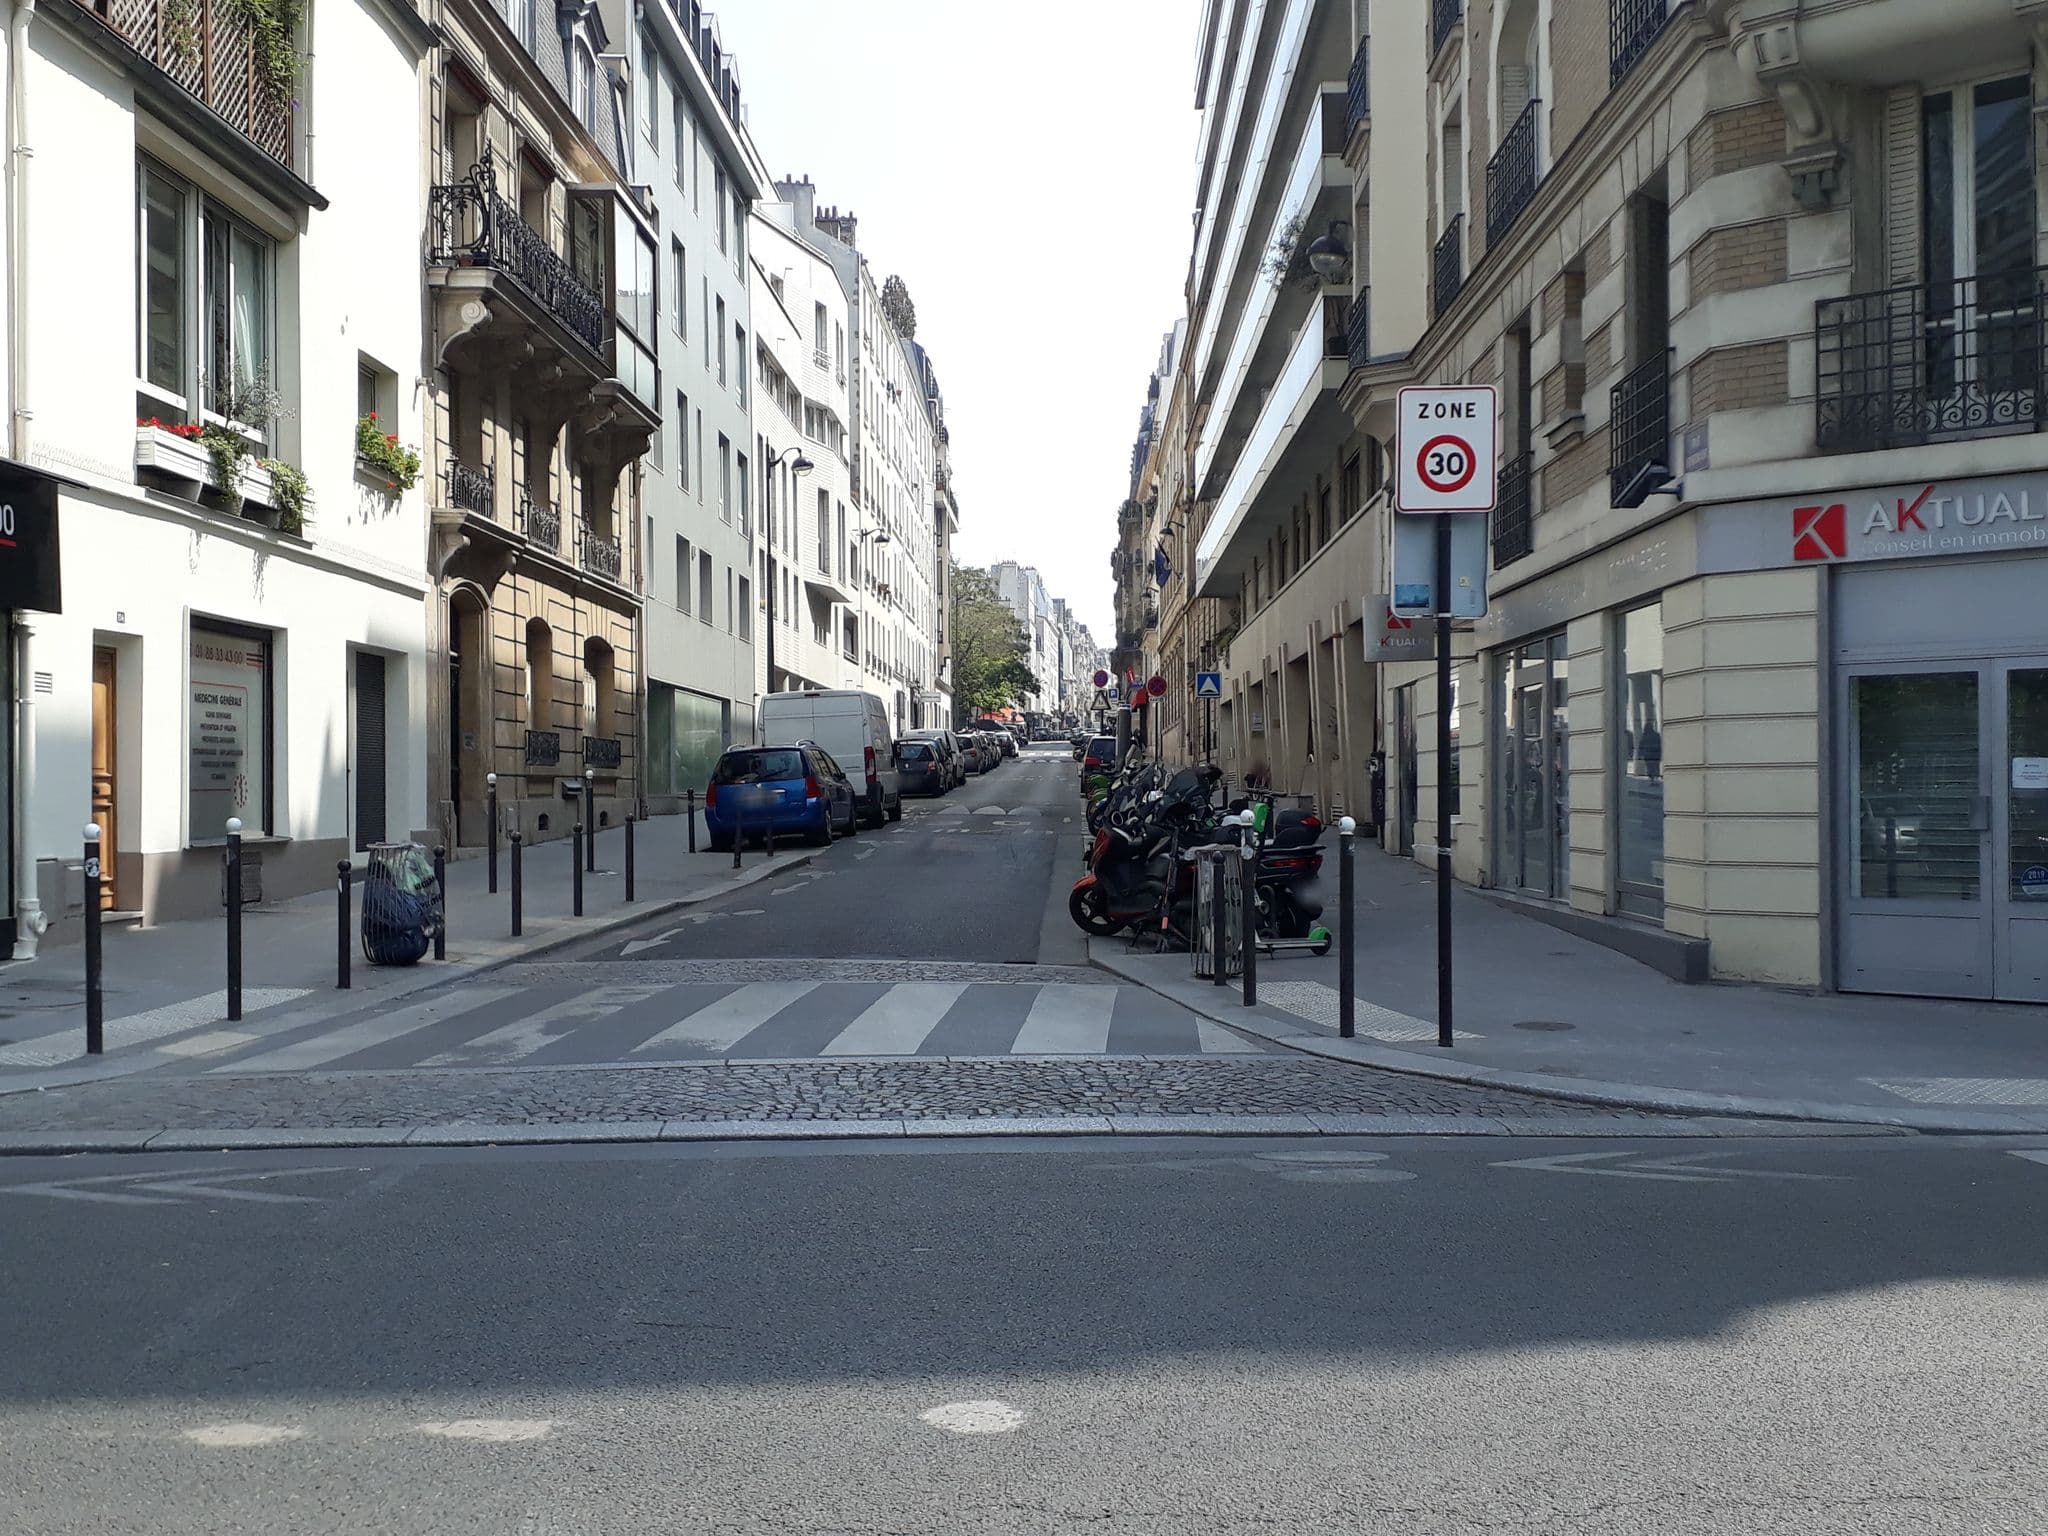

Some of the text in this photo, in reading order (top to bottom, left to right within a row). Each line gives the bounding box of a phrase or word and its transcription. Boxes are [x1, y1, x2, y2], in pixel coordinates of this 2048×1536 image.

[1418, 402, 1476, 419] ZONE
[1429, 452, 1464, 476] 30
[1863, 484, 2048, 535] AKTUAL
[1940, 534, 1963, 549] en
